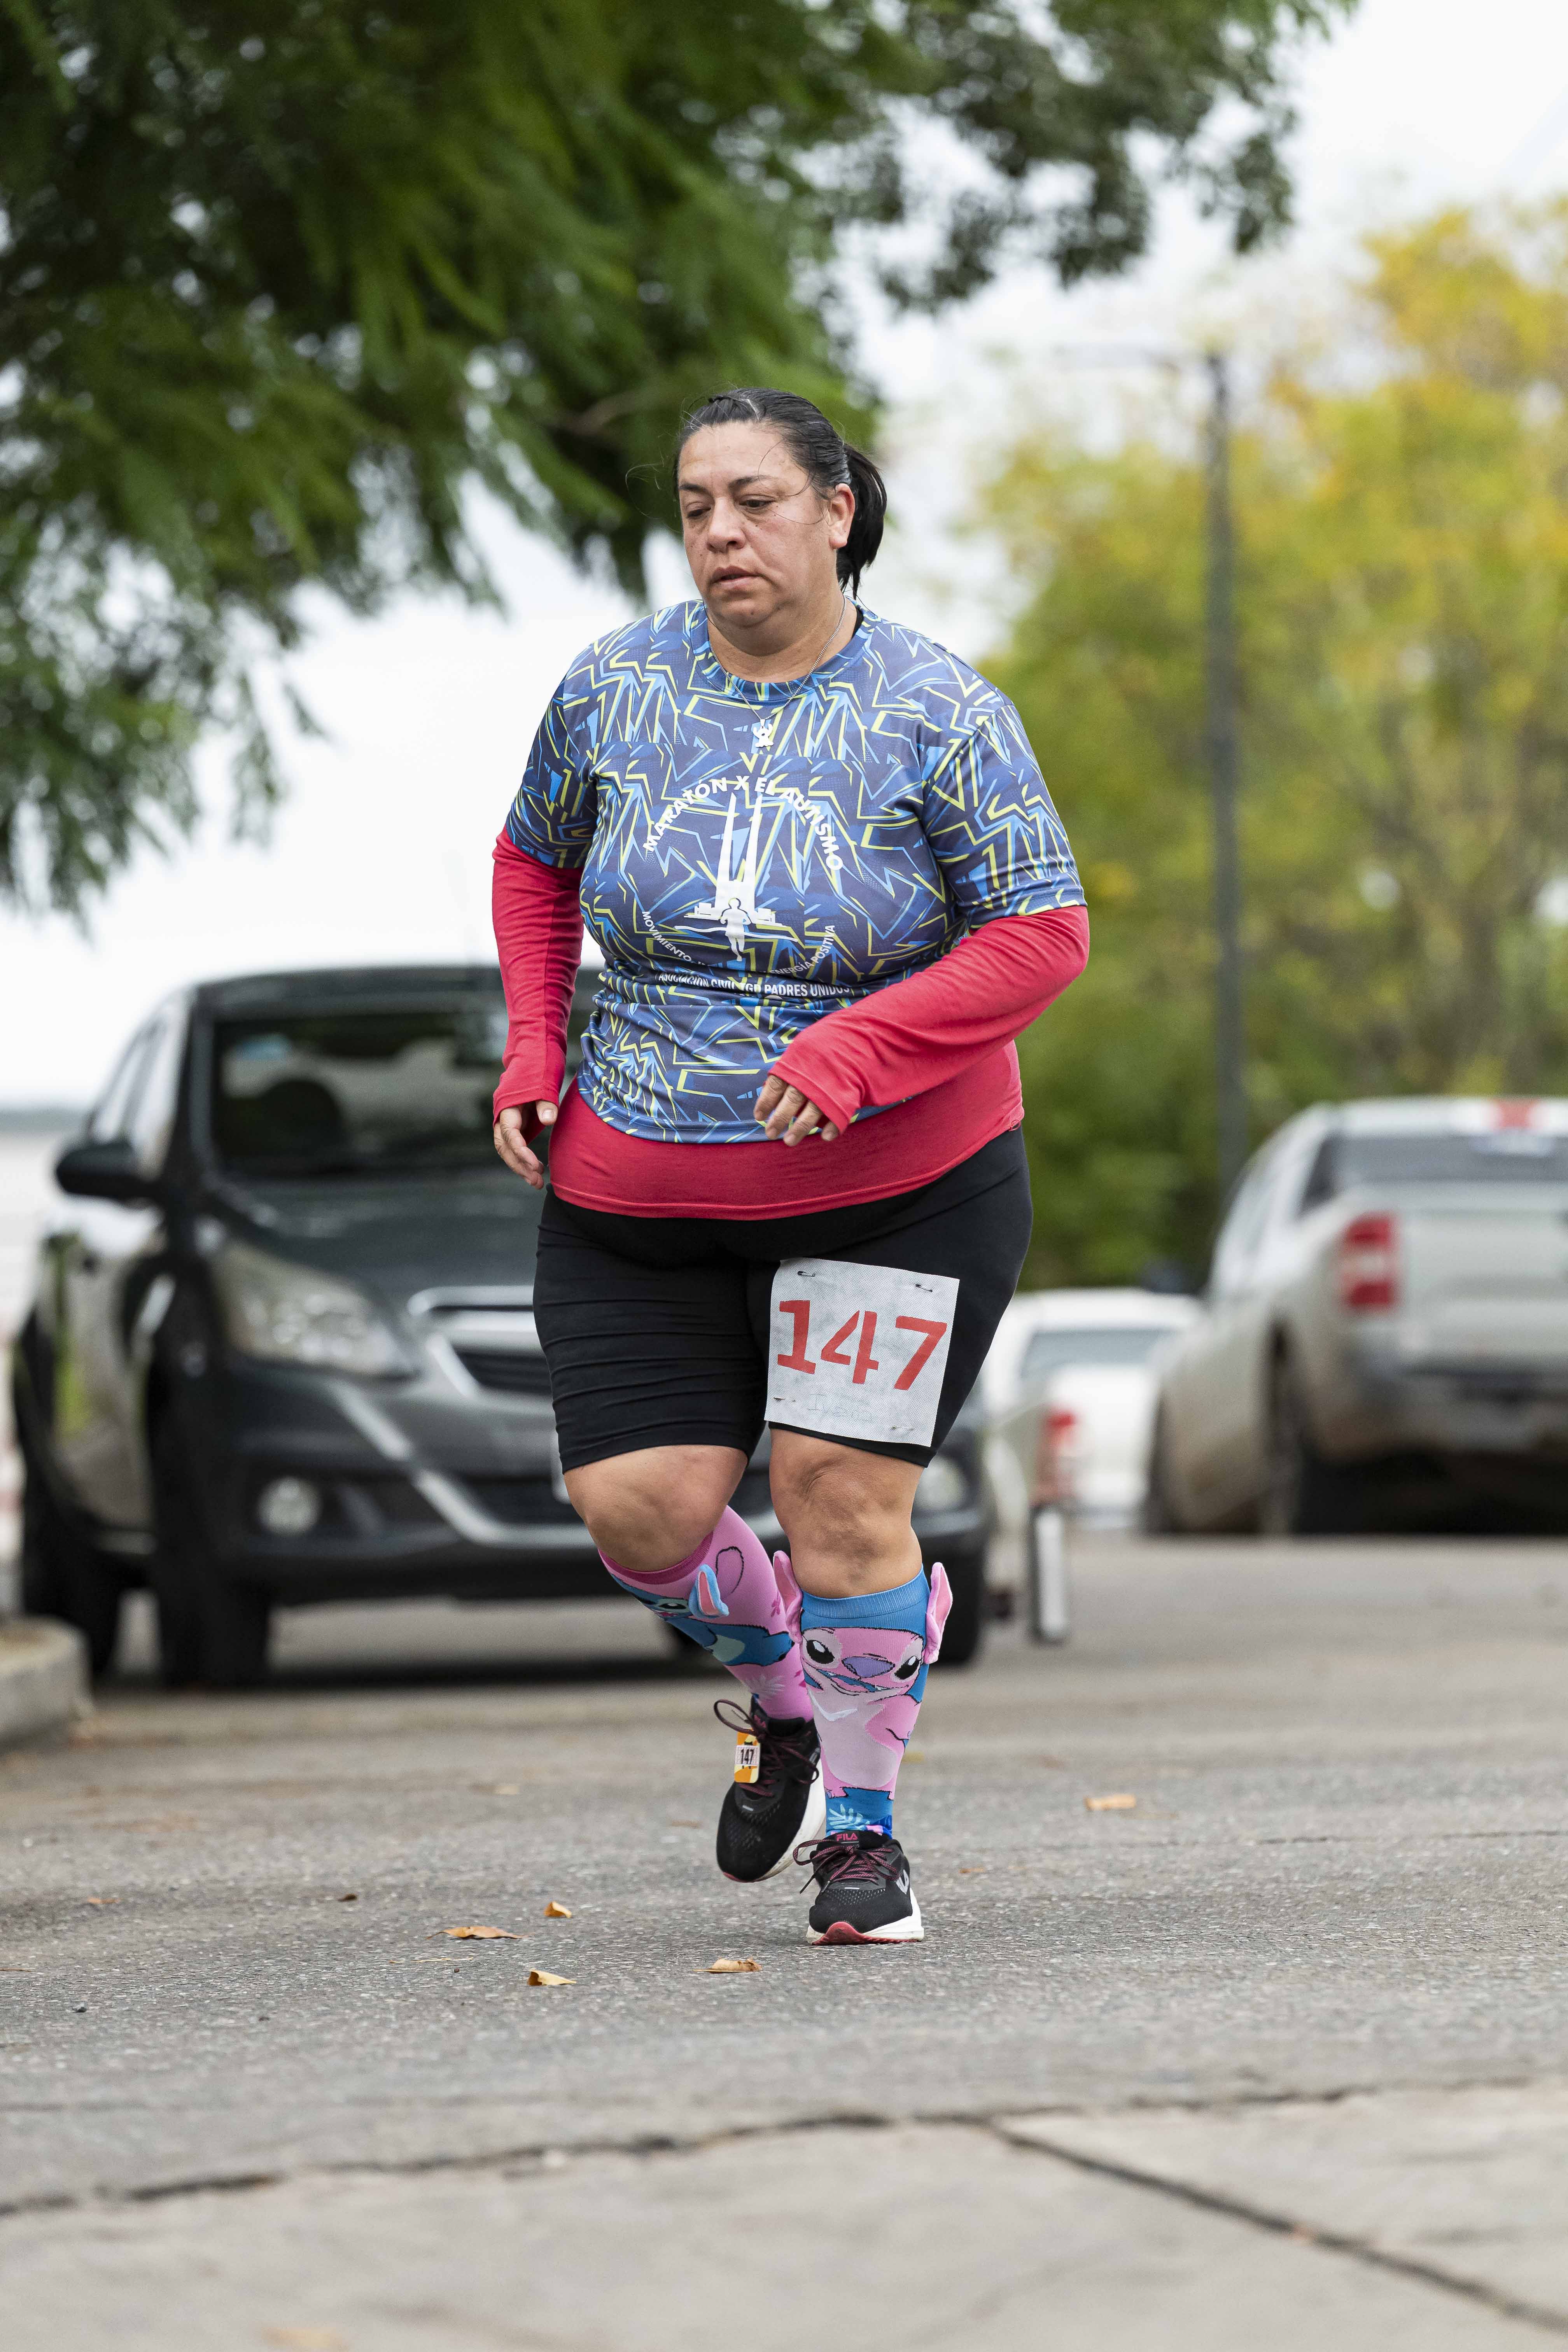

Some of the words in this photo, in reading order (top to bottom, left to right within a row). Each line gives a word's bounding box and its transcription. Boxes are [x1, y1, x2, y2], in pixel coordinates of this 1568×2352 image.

[642, 777, 728, 852] MARATÓN
[733, 775, 750, 790] X
[754, 777, 775, 796] EL
[779, 788, 844, 870] AUTISMO
[642, 911, 692, 961] MOVIMIENTO
[810, 925, 835, 963] POSITIVA
[764, 984, 808, 997] PADRES
[777, 1300, 947, 1391] 147
[740, 1748, 755, 1765] 147
[836, 1832, 858, 1842] FILA
